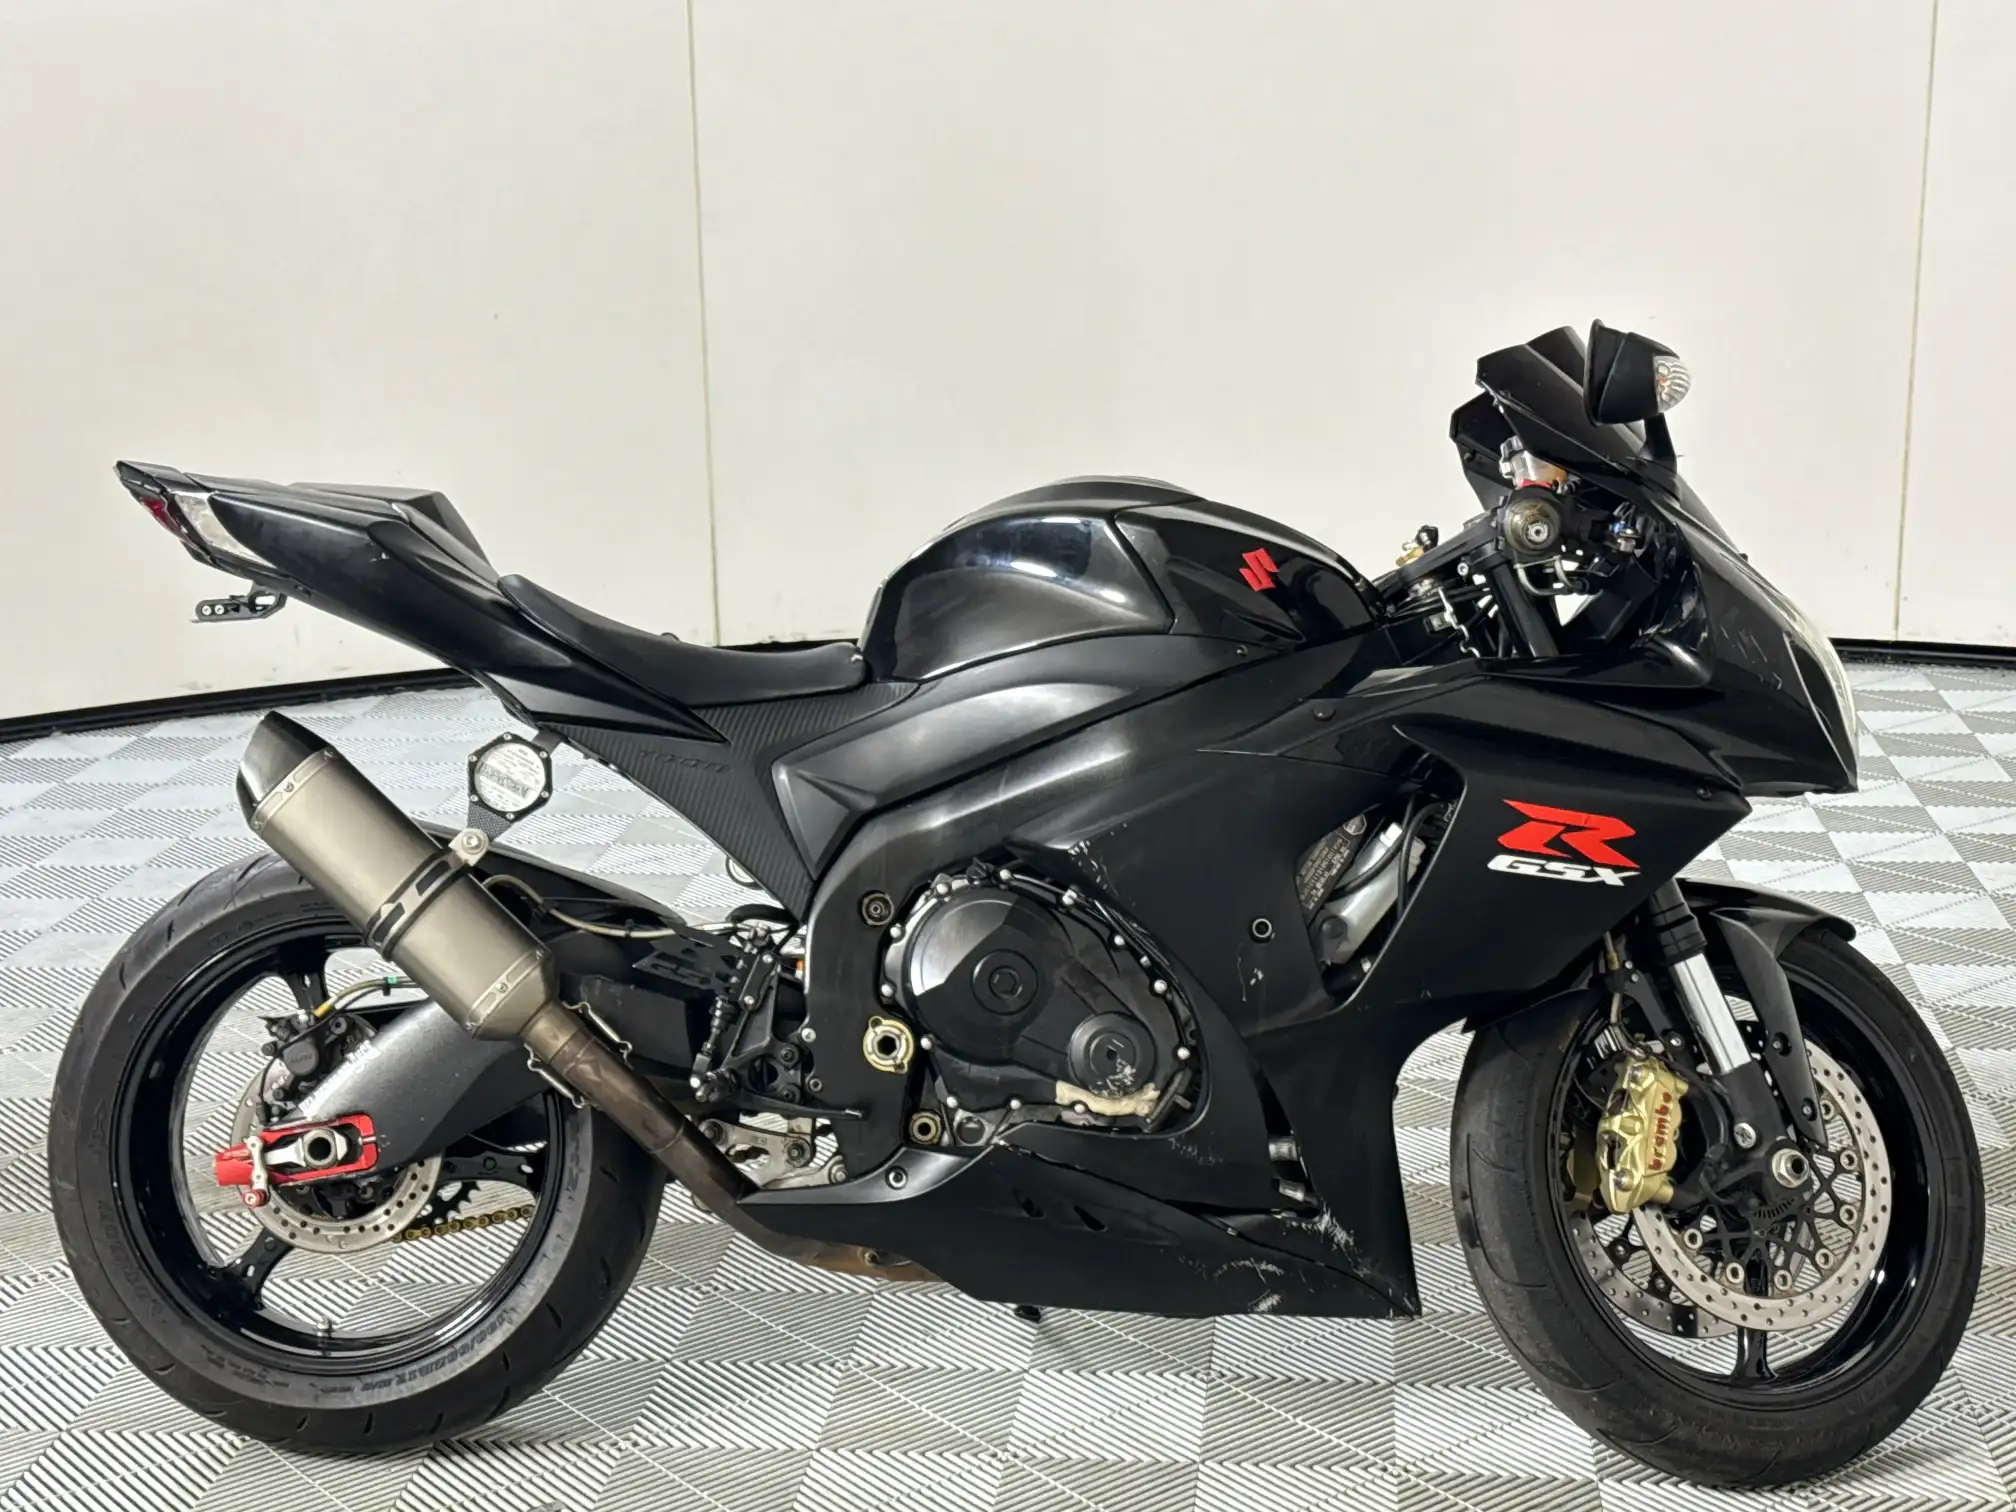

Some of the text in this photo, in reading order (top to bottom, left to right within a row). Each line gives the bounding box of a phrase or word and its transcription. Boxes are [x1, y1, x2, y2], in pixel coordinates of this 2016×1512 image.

[1496, 798, 1640, 868] R
[1487, 855, 1641, 887] GSX
[1648, 1091, 1673, 1171] brembo
